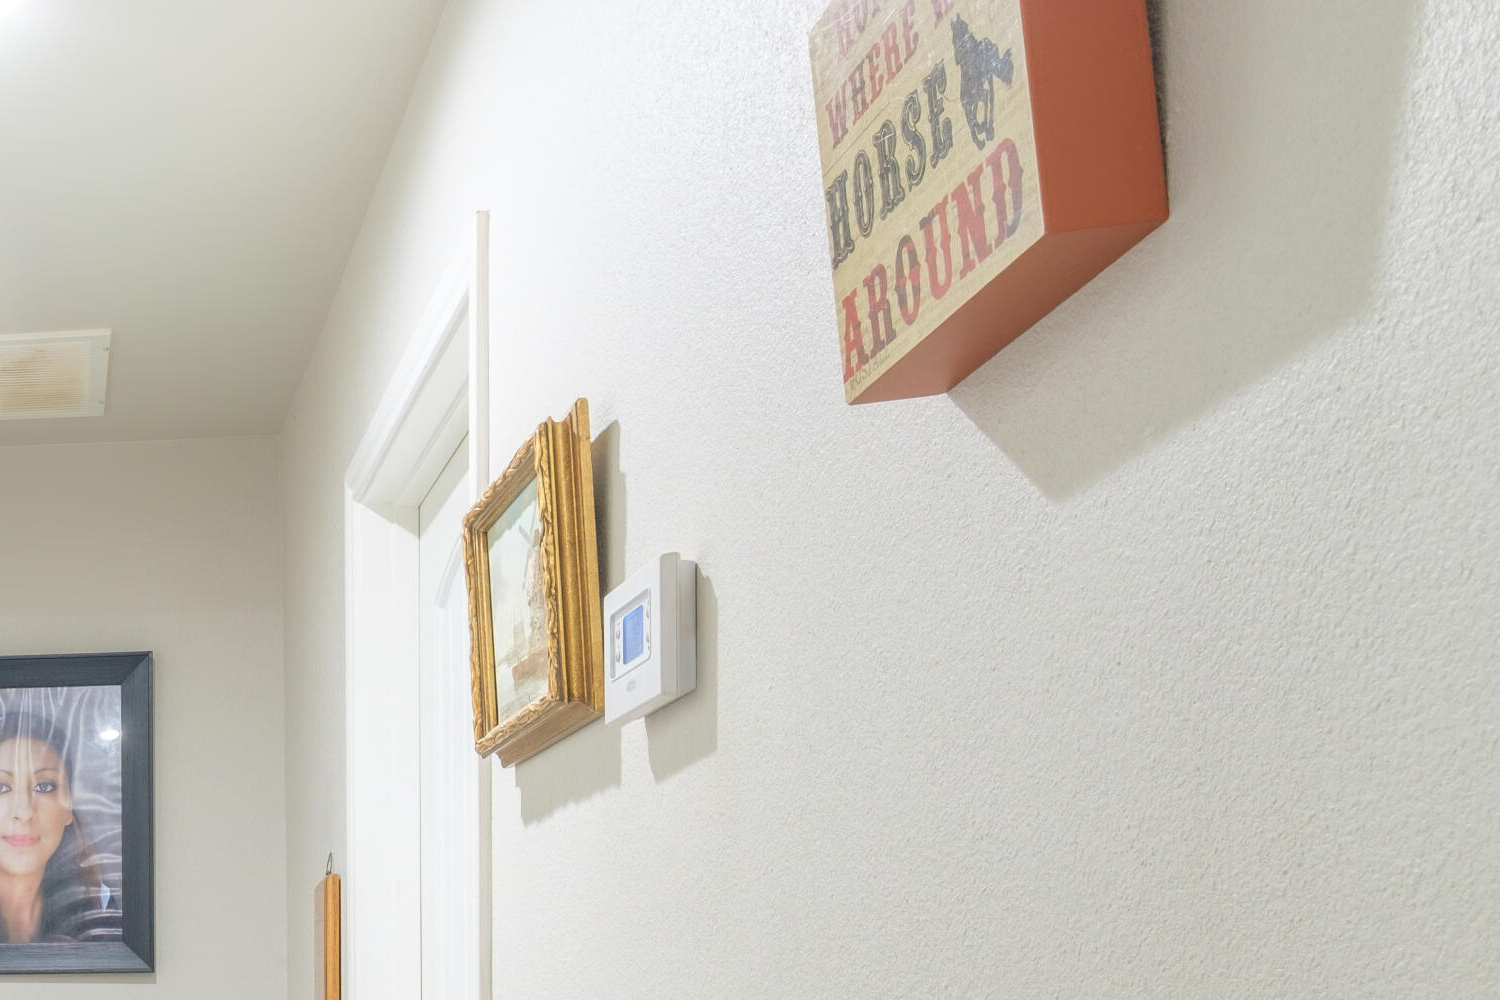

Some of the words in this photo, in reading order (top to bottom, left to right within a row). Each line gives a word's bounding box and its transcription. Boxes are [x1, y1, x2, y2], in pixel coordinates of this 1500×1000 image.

[825, 0, 918, 149] WHERE
[831, 0, 881, 60] HO
[825, 58, 953, 271] HORSE
[842, 138, 1024, 384] AROUND
